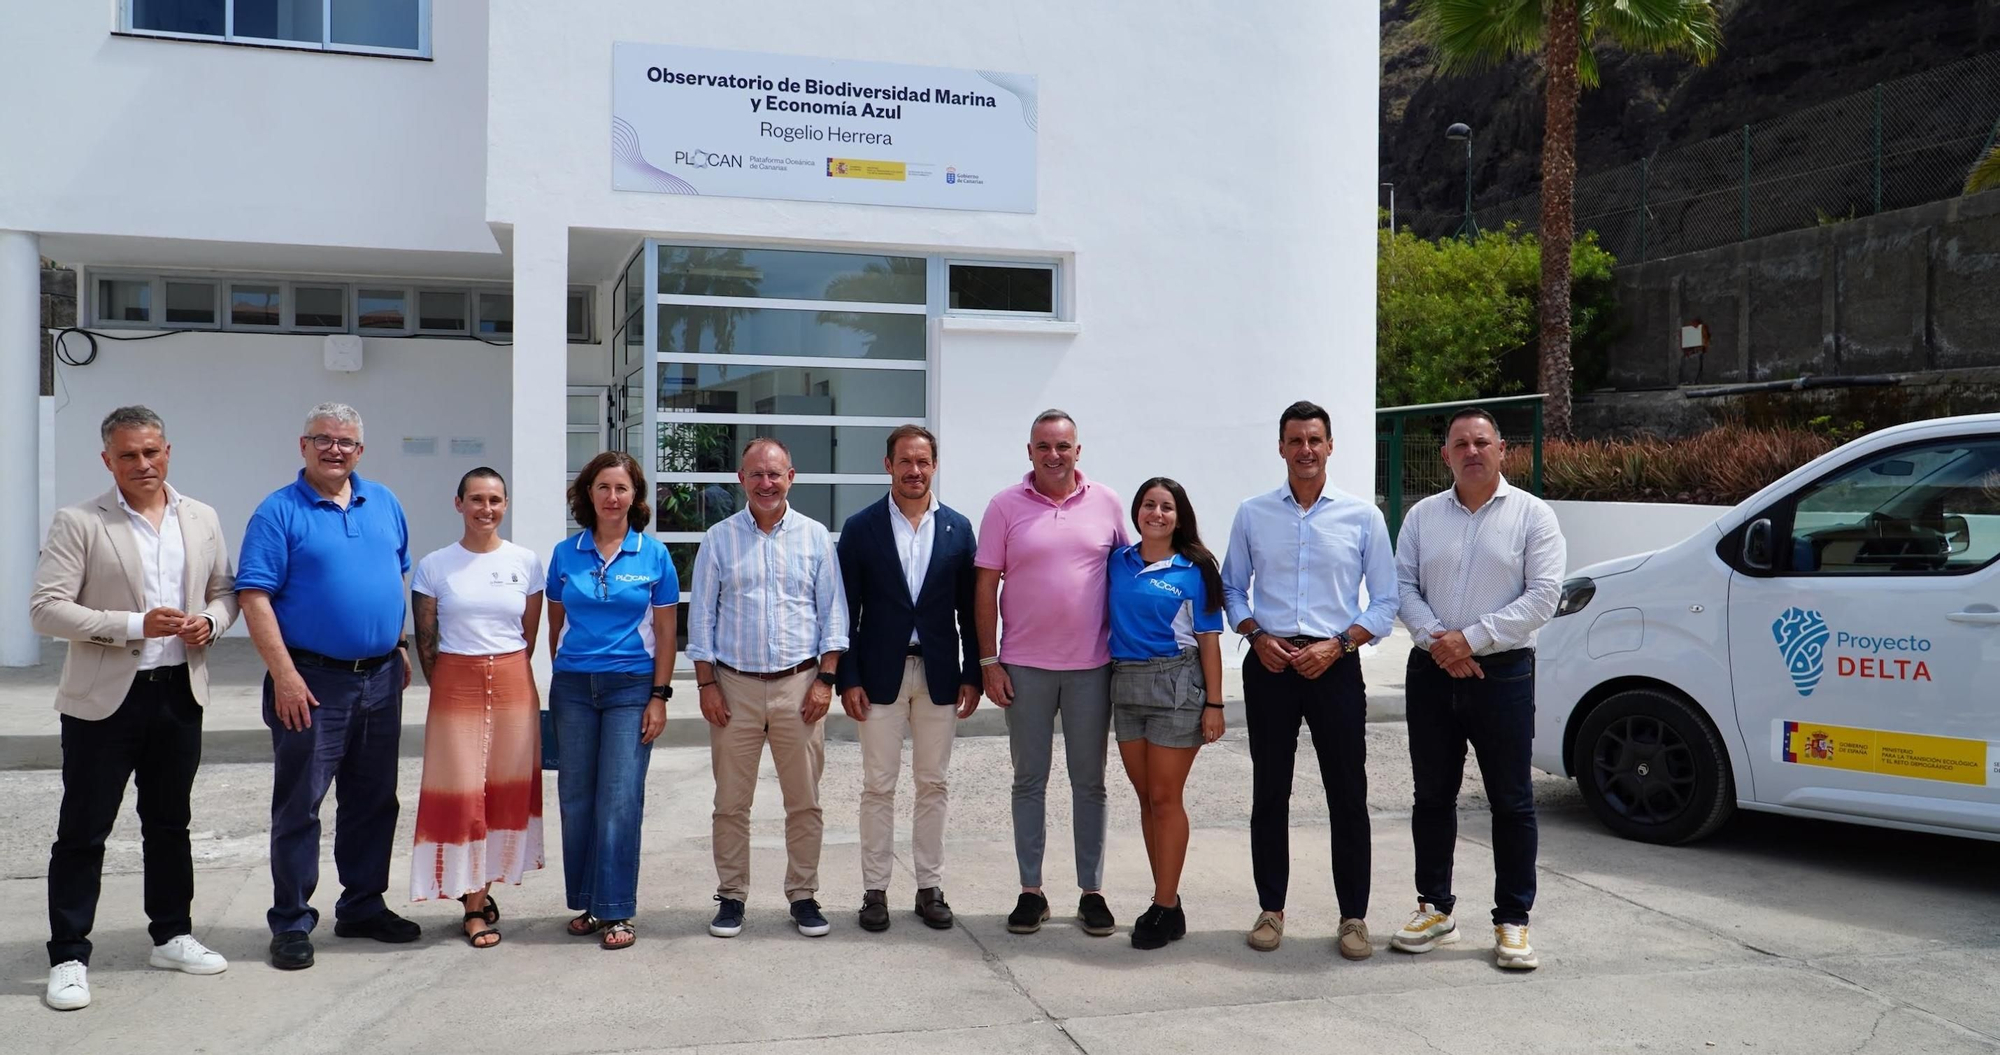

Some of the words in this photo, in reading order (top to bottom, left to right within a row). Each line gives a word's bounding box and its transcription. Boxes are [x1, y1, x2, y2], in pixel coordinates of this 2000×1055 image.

[647, 66, 774, 91] Observatorio
[777, 77, 801, 93] de
[805, 79, 930, 103] Biodiversidad
[935, 88, 997, 107] Marina
[750, 98, 762, 112] y
[766, 95, 857, 116] Economía
[861, 102, 901, 119] Azul
[760, 121, 823, 143] Rogelio
[828, 126, 893, 146] Herrera
[675, 149, 742, 169] PLOCAN
[750, 155, 784, 164] Plataforma
[785, 157, 815, 166] Oceánica
[759, 163, 787, 171] Canarias
[615, 574, 650, 582] PLOCAN
[1149, 578, 1182, 597] PLOCAN
[1837, 631, 1931, 654] Proyecto
[1838, 656, 1932, 682] DELTA
[1839, 742, 1868, 750] GOBIERNO
[1882, 747, 1914, 755] MINISTERIO
[1906, 755, 1941, 764] TRANSICIÓN
[1942, 758, 1979, 767] ECOLÓGICA
[1910, 761, 1954, 770] DEMOGRÁFICO
